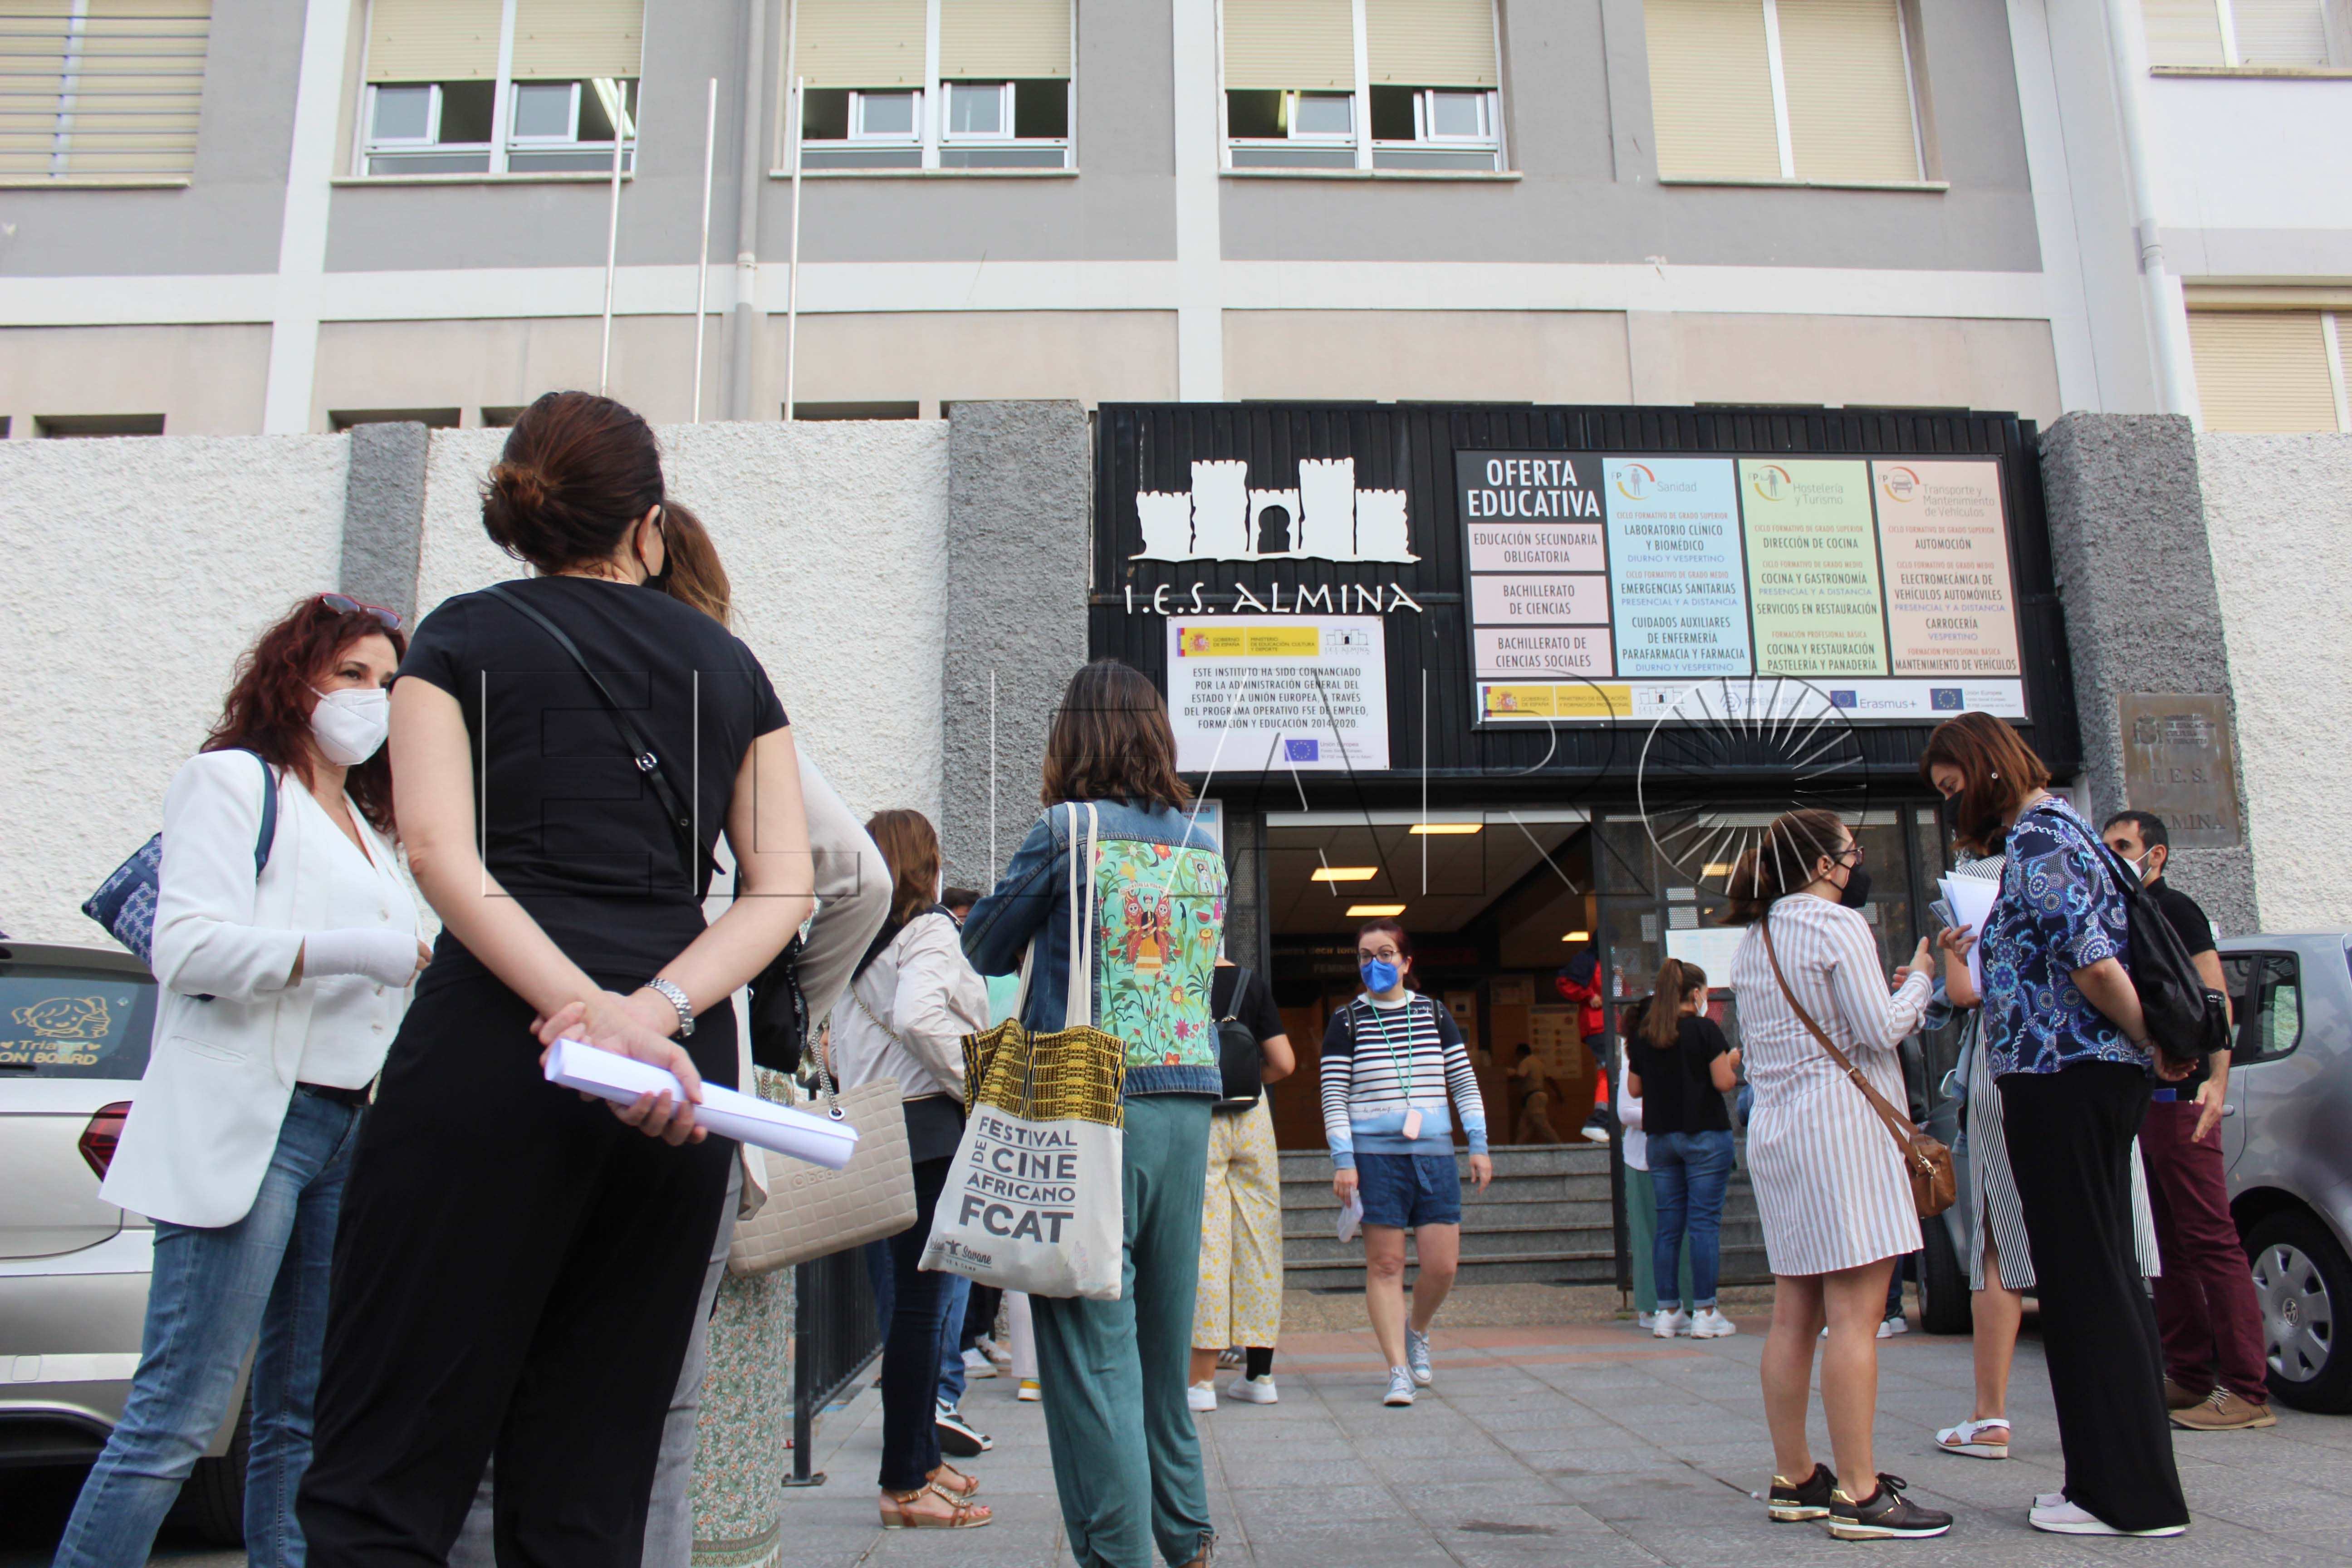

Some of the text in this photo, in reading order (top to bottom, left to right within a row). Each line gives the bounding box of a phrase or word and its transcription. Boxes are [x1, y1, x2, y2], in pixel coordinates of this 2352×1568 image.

[1486, 459, 1578, 487] OFERTA
[1657, 481, 1697, 492] Sanidad
[1793, 483, 1843, 493] Hostelería
[1923, 485, 1982, 496] Transporte y
[1468, 490, 1601, 517] EDUCATIVA
[1795, 494, 1843, 506] y Turismo
[1924, 496, 1994, 506] Mantenimiento
[1925, 508, 1984, 517] de Vehículos
[1625, 524, 1722, 535] LABORATORIO CLÍNICO
[1474, 531, 1597, 545] EDUCACIÓN SECUNDARIA
[1764, 536, 1858, 548] DIRECCIÓN DE COCINA
[1916, 538, 1971, 549] AUTOMOCIÓN
[1646, 539, 1704, 550] Y BIOMÉDICO
[1504, 551, 1570, 562] OBLIGATORIA
[1762, 572, 1867, 584] COCINA Y GASTRONOMÍA
[1901, 573, 1993, 585] ELECTROMECÁNICA DE
[1504, 585, 1574, 597] BACHILLERATO
[1622, 583, 1735, 594] EMERGENCIAS SANITARIAS
[1895, 588, 2002, 600] VEHÍCULOS AUTOMÓVILES
[1125, 582, 1423, 615] I.E.S. ALMINA
[1510, 603, 1571, 614] DE CIENCIAS
[1757, 603, 1877, 614] SERVICIOS EN RESTAURACIÓN
[1632, 617, 1730, 627] CUIDADOS AUXILIARES
[1926, 617, 1978, 629] CARROCERÍA
[1648, 632, 1717, 643] DE ENFERMERÍA
[1772, 630, 1805, 638] FORMACIÓN
[1498, 637, 1586, 649] BACHILLERATO DE
[1767, 642, 1874, 654] COCINA Y RESTAURACIÓN
[1623, 649, 1744, 659] PARAFARMACIA Y FARMACIA
[1496, 655, 1591, 667] CIENCIAS SOCIALES
[1768, 658, 1877, 670] PASTELERÍA Y PANADERÍA
[1896, 658, 2016, 670] MANTENIMIENTO DE VEHÍCULOS
[1193, 668, 1361, 676] ESTE INSTITUTO HA SIDO COFINANCIADO
[1196, 679, 1359, 690] POR LA ADMINISTRACIÓN GENERAL DEL
[1192, 694, 1223, 702] ESTADO
[1248, 691, 1276, 702] UNIÓN
[1279, 693, 1320, 704] EUROPEA,
[1323, 694, 1328, 702] A
[1332, 692, 1361, 702] TRAVÉS
[1184, 707, 1200, 716] DEL
[1254, 706, 1298, 715] OPERATIVO
[1303, 706, 1315, 715] FSE
[1320, 706, 1330, 715] DE
[1333, 706, 1369, 716] EMPLEO,
[1198, 718, 1248, 728] FORMACIÓN
[1260, 717, 1308, 728] EDUCACIÓN
[1312, 719, 1359, 728] 20142020.
[2159, 814, 2226, 829] MINA
[0, 1052, 98, 1065] ON BOARD
[979, 1116, 1078, 1147] FESTIVAL
[972, 1140, 987, 1163] DE
[992, 1148, 1078, 1179] CINE
[967, 1171, 1076, 1202] AFRICANO
[959, 1194, 1073, 1244] FCAT
[962, 1245, 991, 1264] Savane
